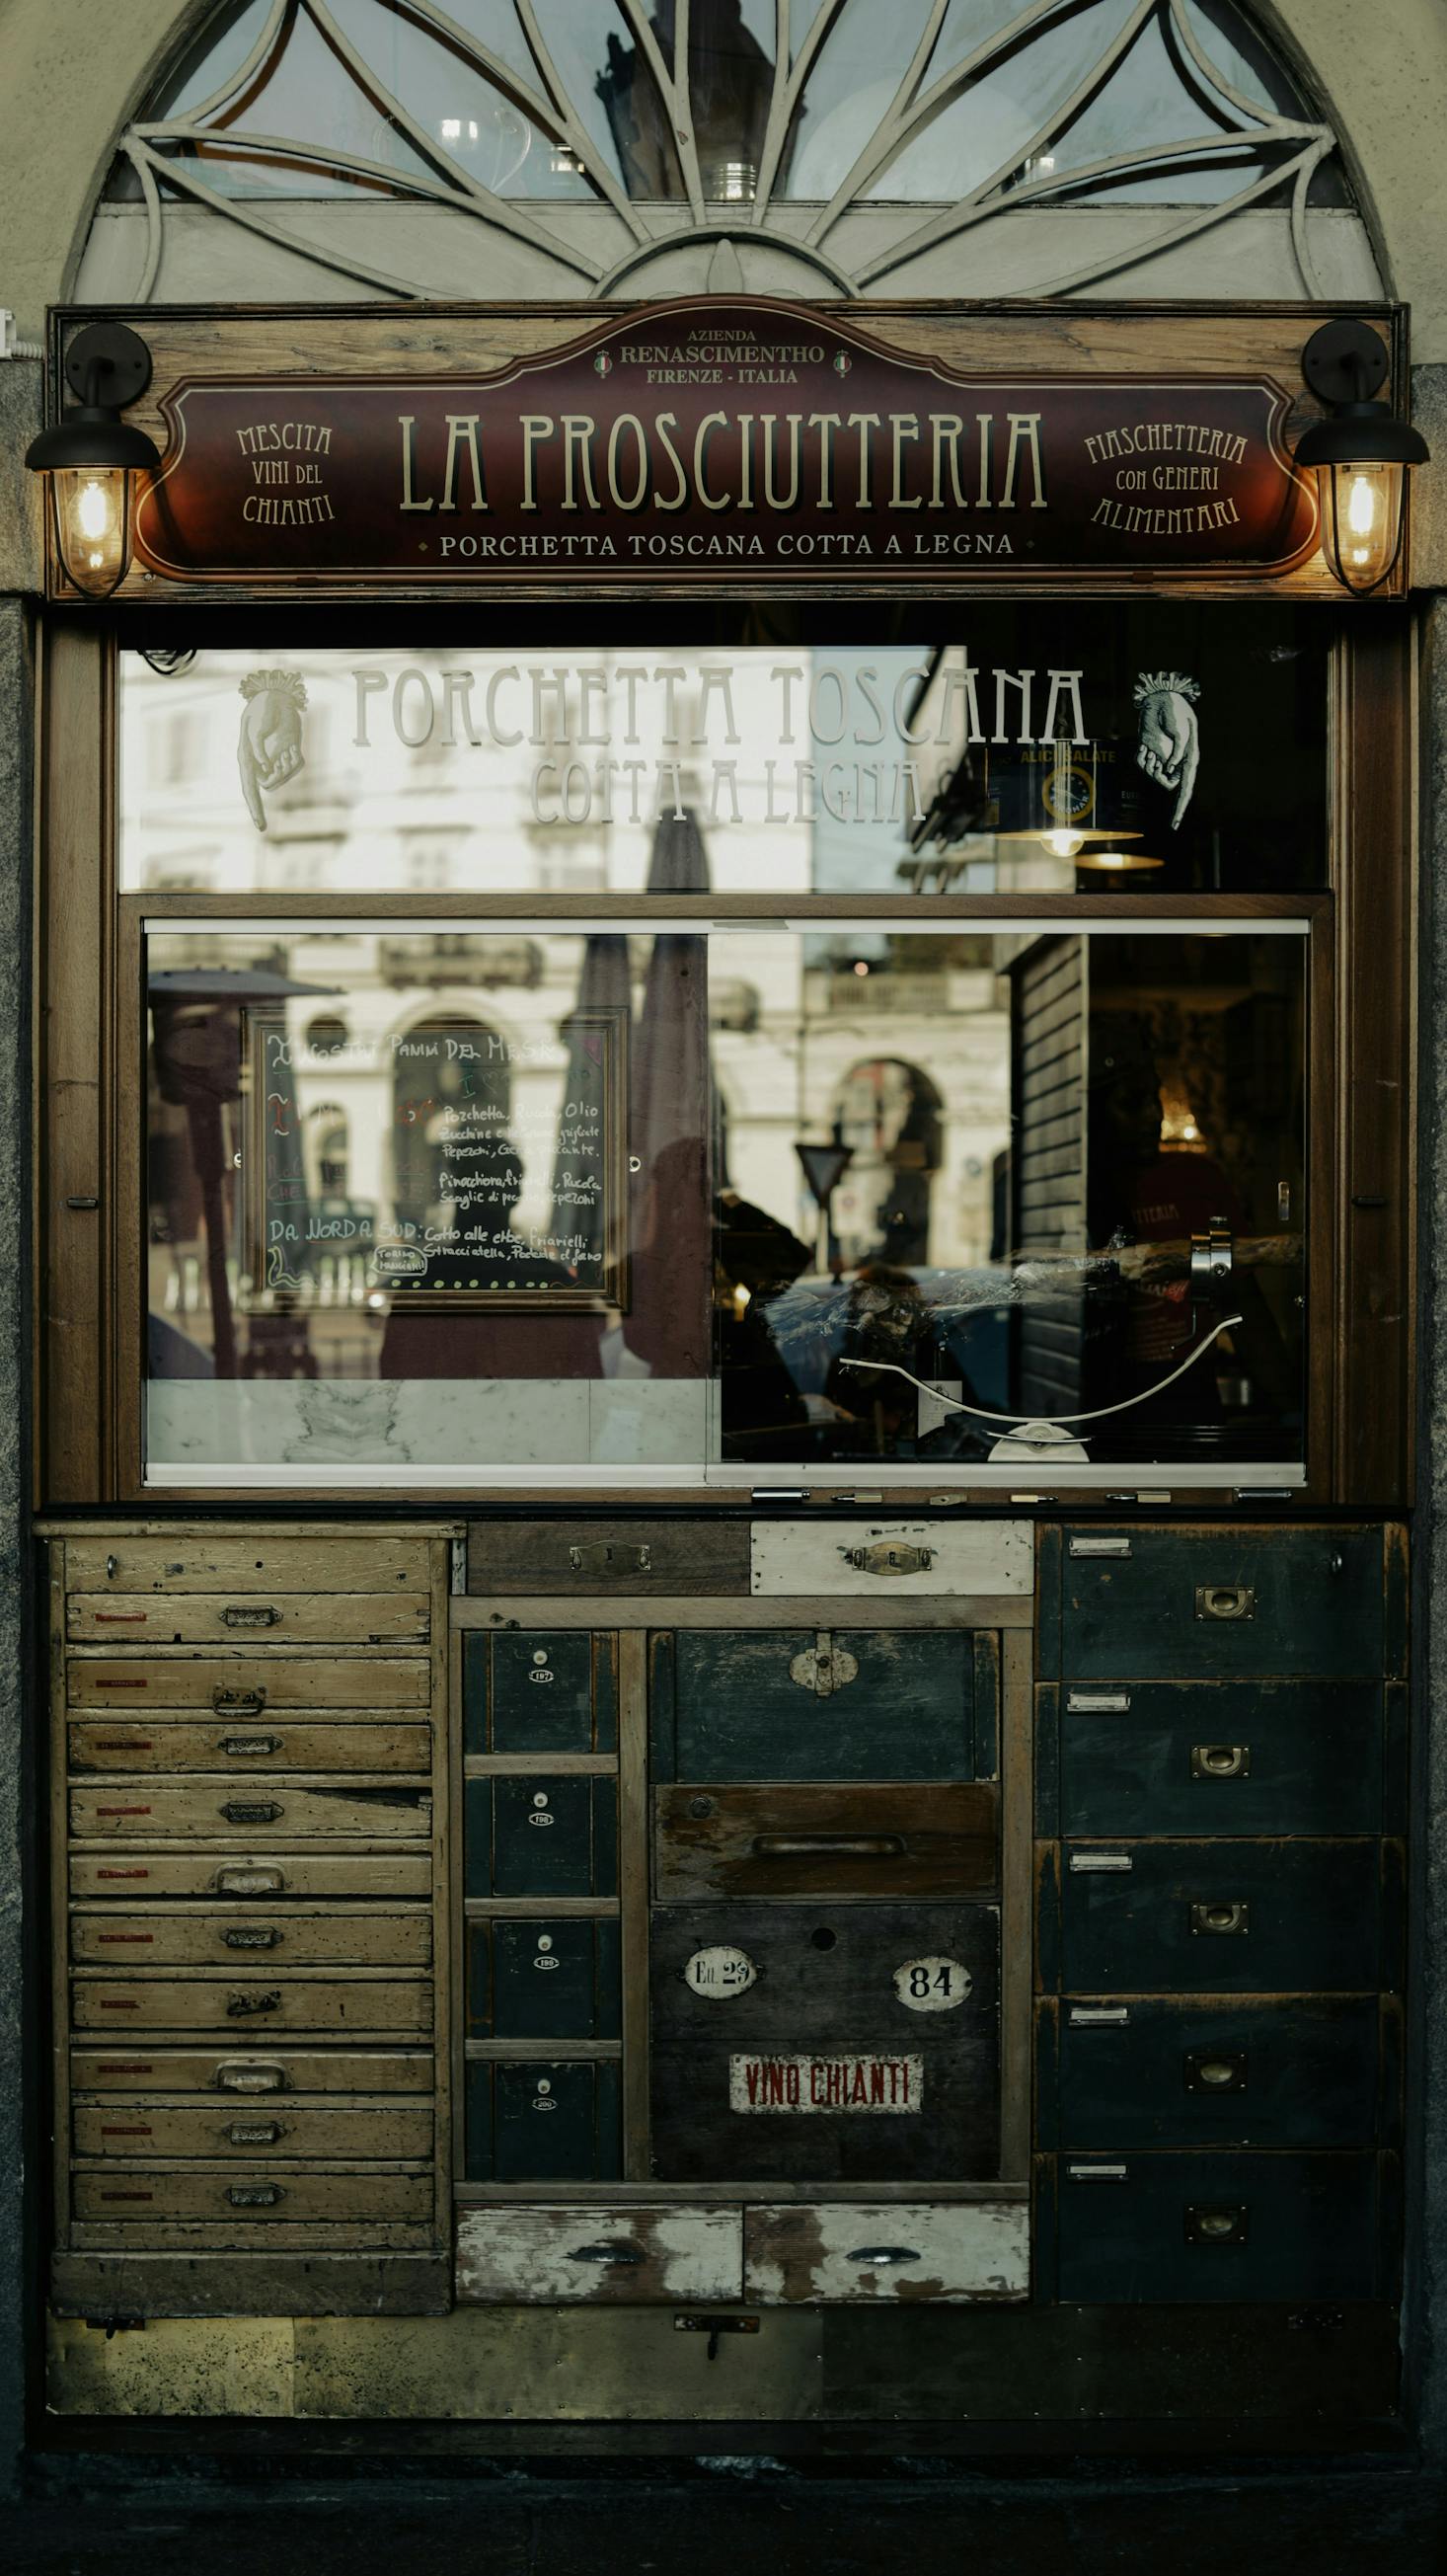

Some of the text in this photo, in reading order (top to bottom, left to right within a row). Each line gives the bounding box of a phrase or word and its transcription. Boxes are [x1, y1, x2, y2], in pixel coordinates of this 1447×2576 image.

[687, 330, 757, 342] AZIENDA
[620, 346, 825, 363] RENASCIMENTHO
[647, 368, 724, 384] FIRENZE
[737, 368, 799, 384] ITALIA
[236, 423, 333, 456] MESCITA
[1084, 423, 1250, 465] FIASCHETTERIA
[252, 460, 324, 485] VINI DEL
[399, 411, 1048, 511] LA PROSCIUTTERIA
[1152, 465, 1220, 491] GENERI
[243, 494, 336, 525] CHIANTI
[1091, 497, 1241, 534] ALIMENTARI
[439, 533, 1014, 557] PORCHETTA TOSCANA COTTA A LEGNA
[351, 665, 1091, 747] PORCHETTA TOSCANA
[530, 759, 927, 824] COTTA A LEGNA
[565, 1101, 598, 1118] Olio
[269, 1219, 299, 1241] DA
[464, 1225, 489, 1241] alle
[909, 1966, 952, 1998] 84
[745, 2063, 909, 2106] VINO CHIANTI
